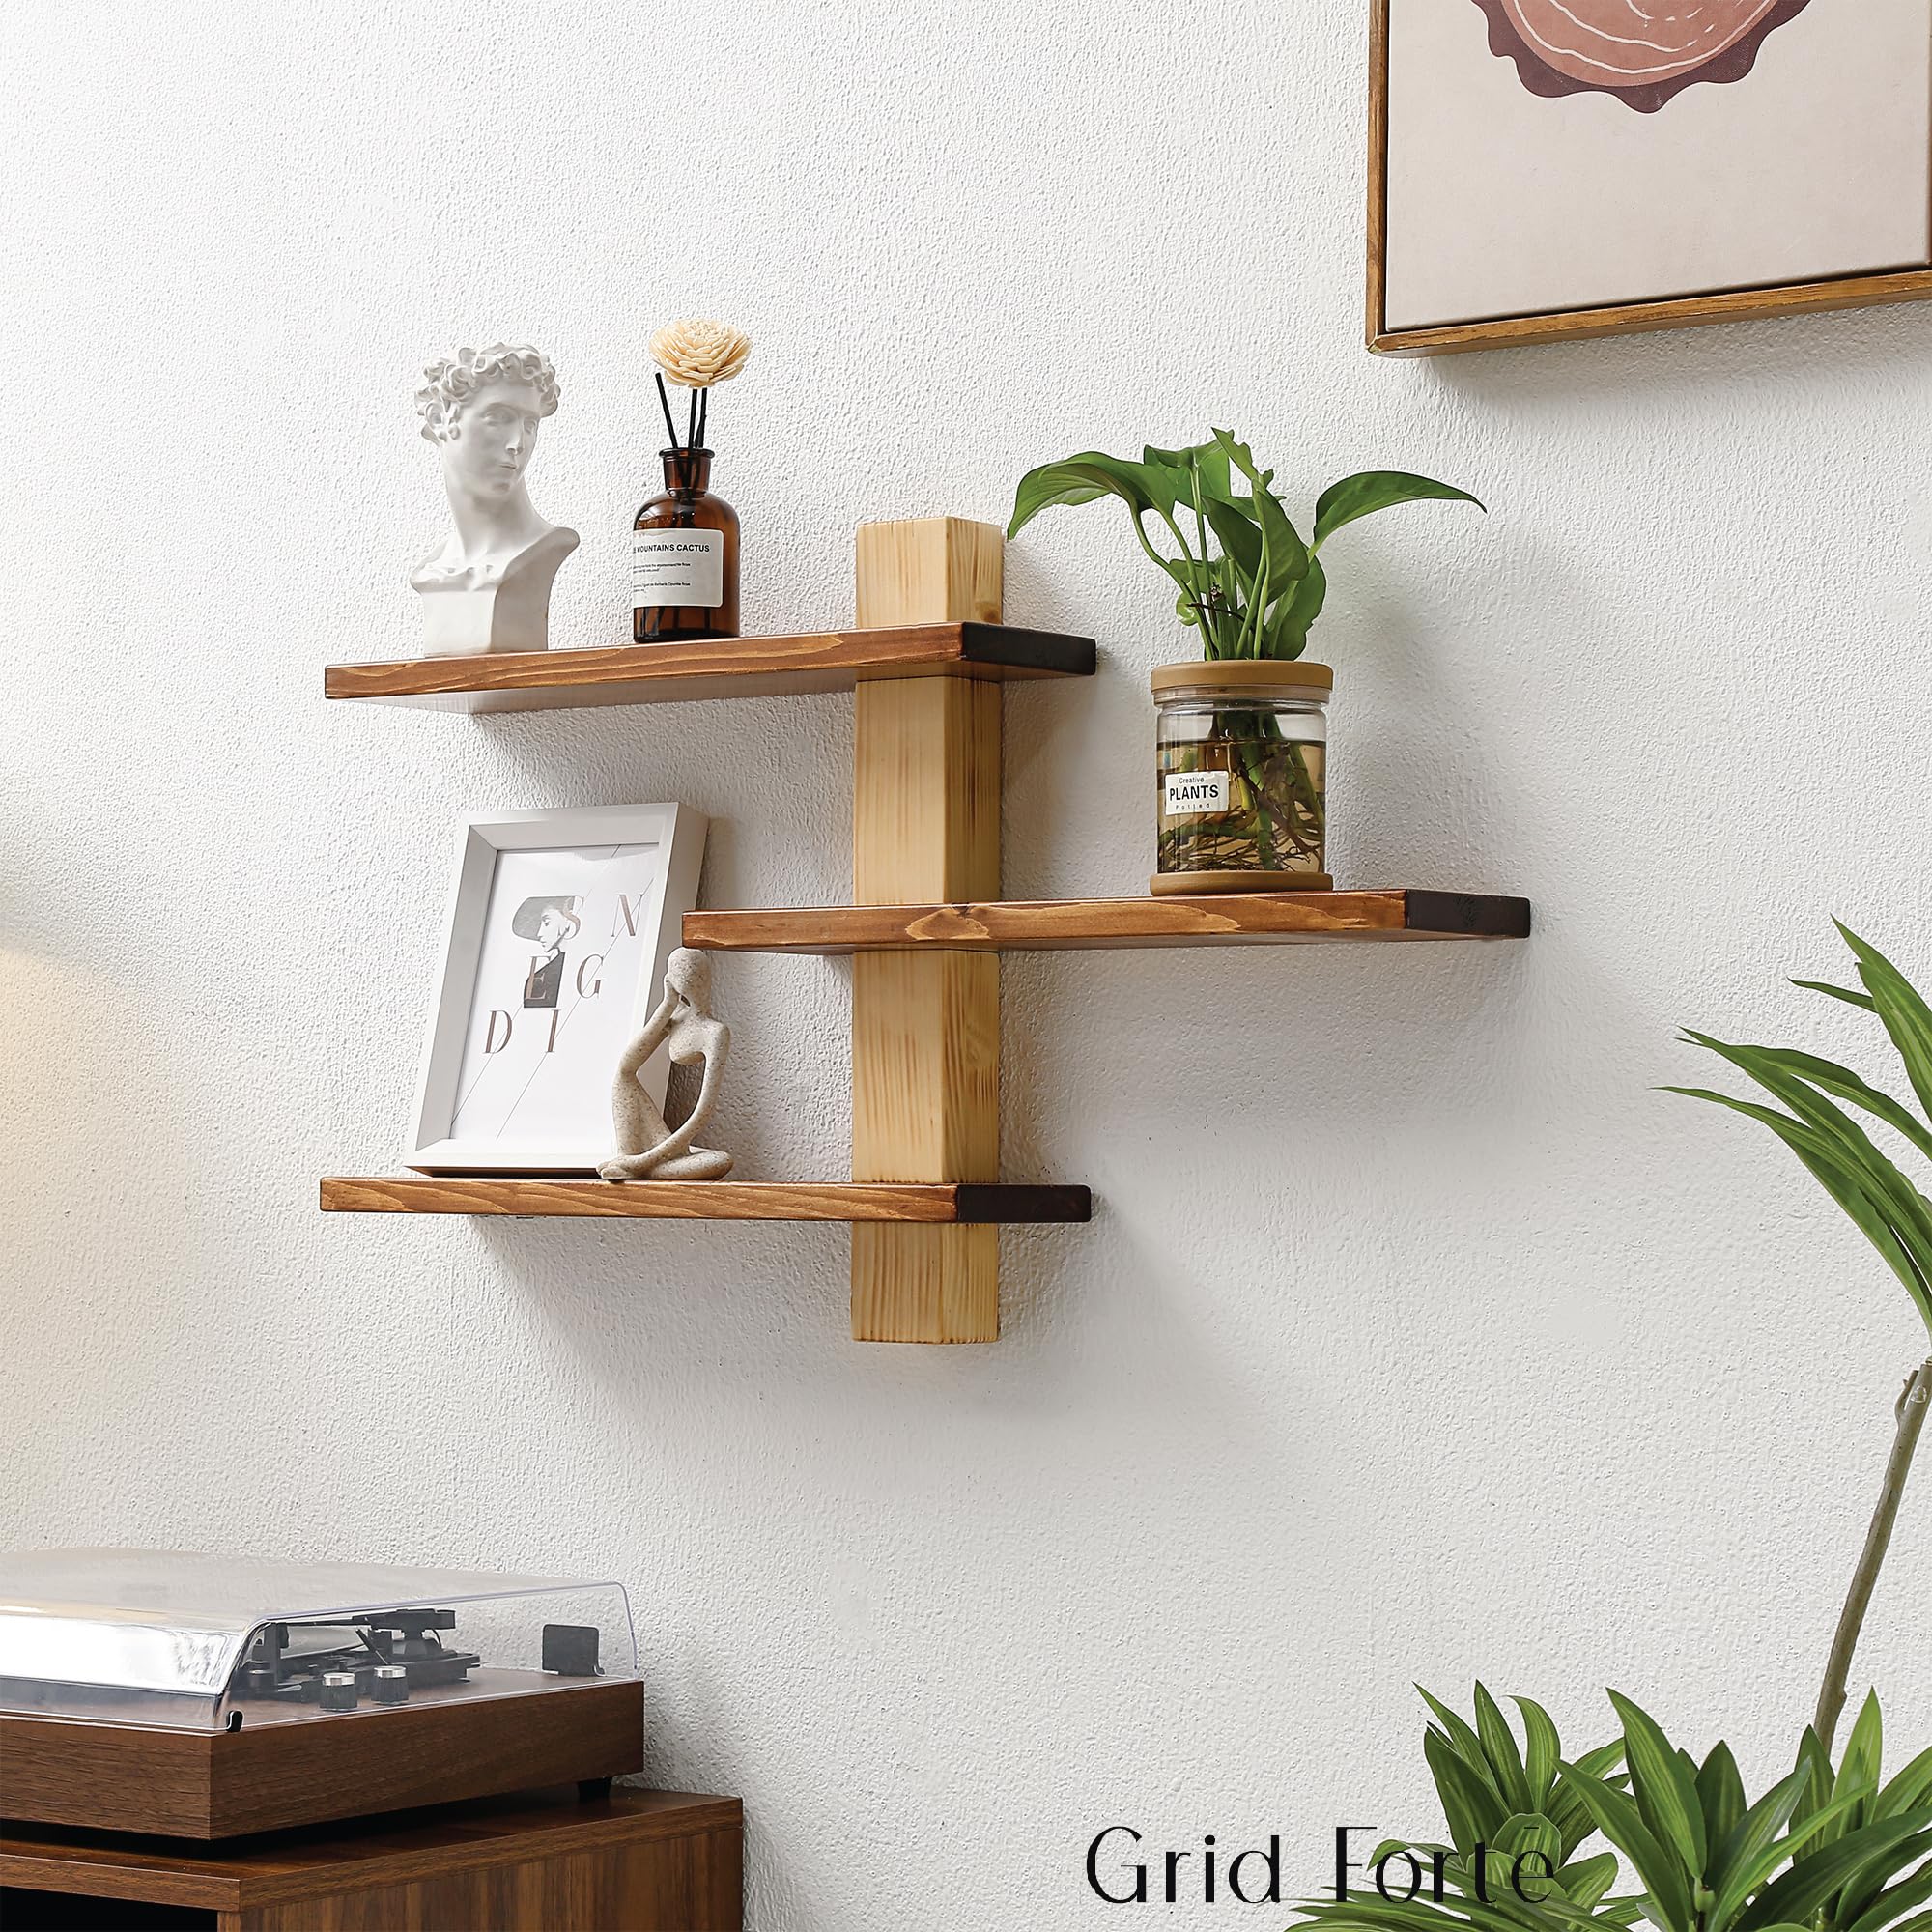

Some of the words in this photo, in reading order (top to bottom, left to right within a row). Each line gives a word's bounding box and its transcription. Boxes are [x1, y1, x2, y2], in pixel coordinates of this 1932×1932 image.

[637, 544, 675, 553] MOUNTAINS
[676, 544, 710, 553] CACTUS
[1169, 784, 1219, 802] PLANTS
